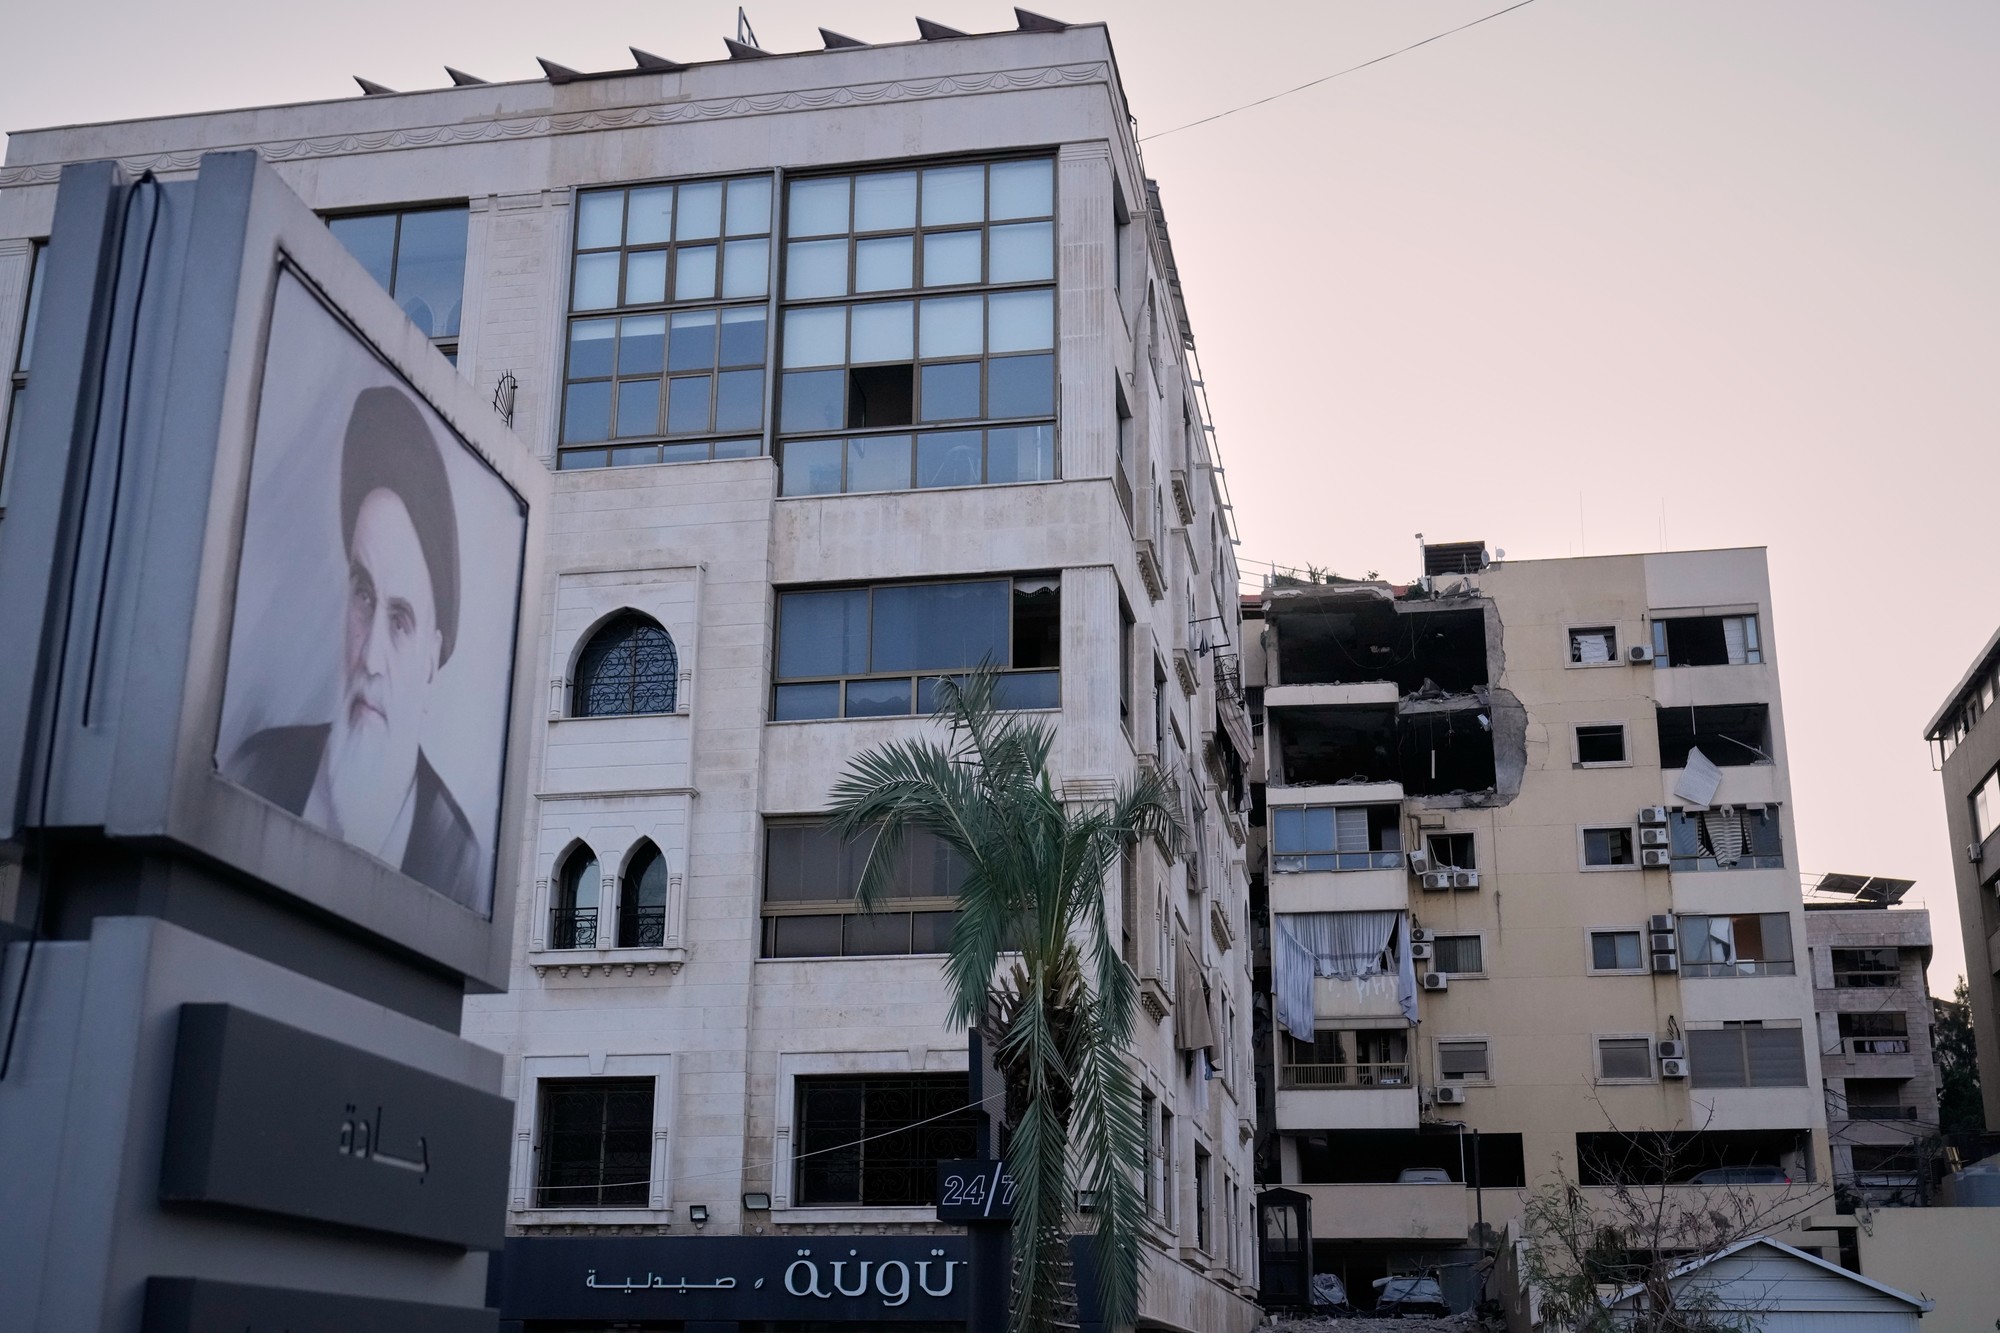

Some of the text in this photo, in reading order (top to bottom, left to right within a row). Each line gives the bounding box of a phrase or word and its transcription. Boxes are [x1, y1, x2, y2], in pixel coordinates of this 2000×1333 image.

[340, 1103, 429, 1185] جادة
[942, 1162, 1018, 1217] 24/7
[586, 1269, 736, 1293] صيدلية
